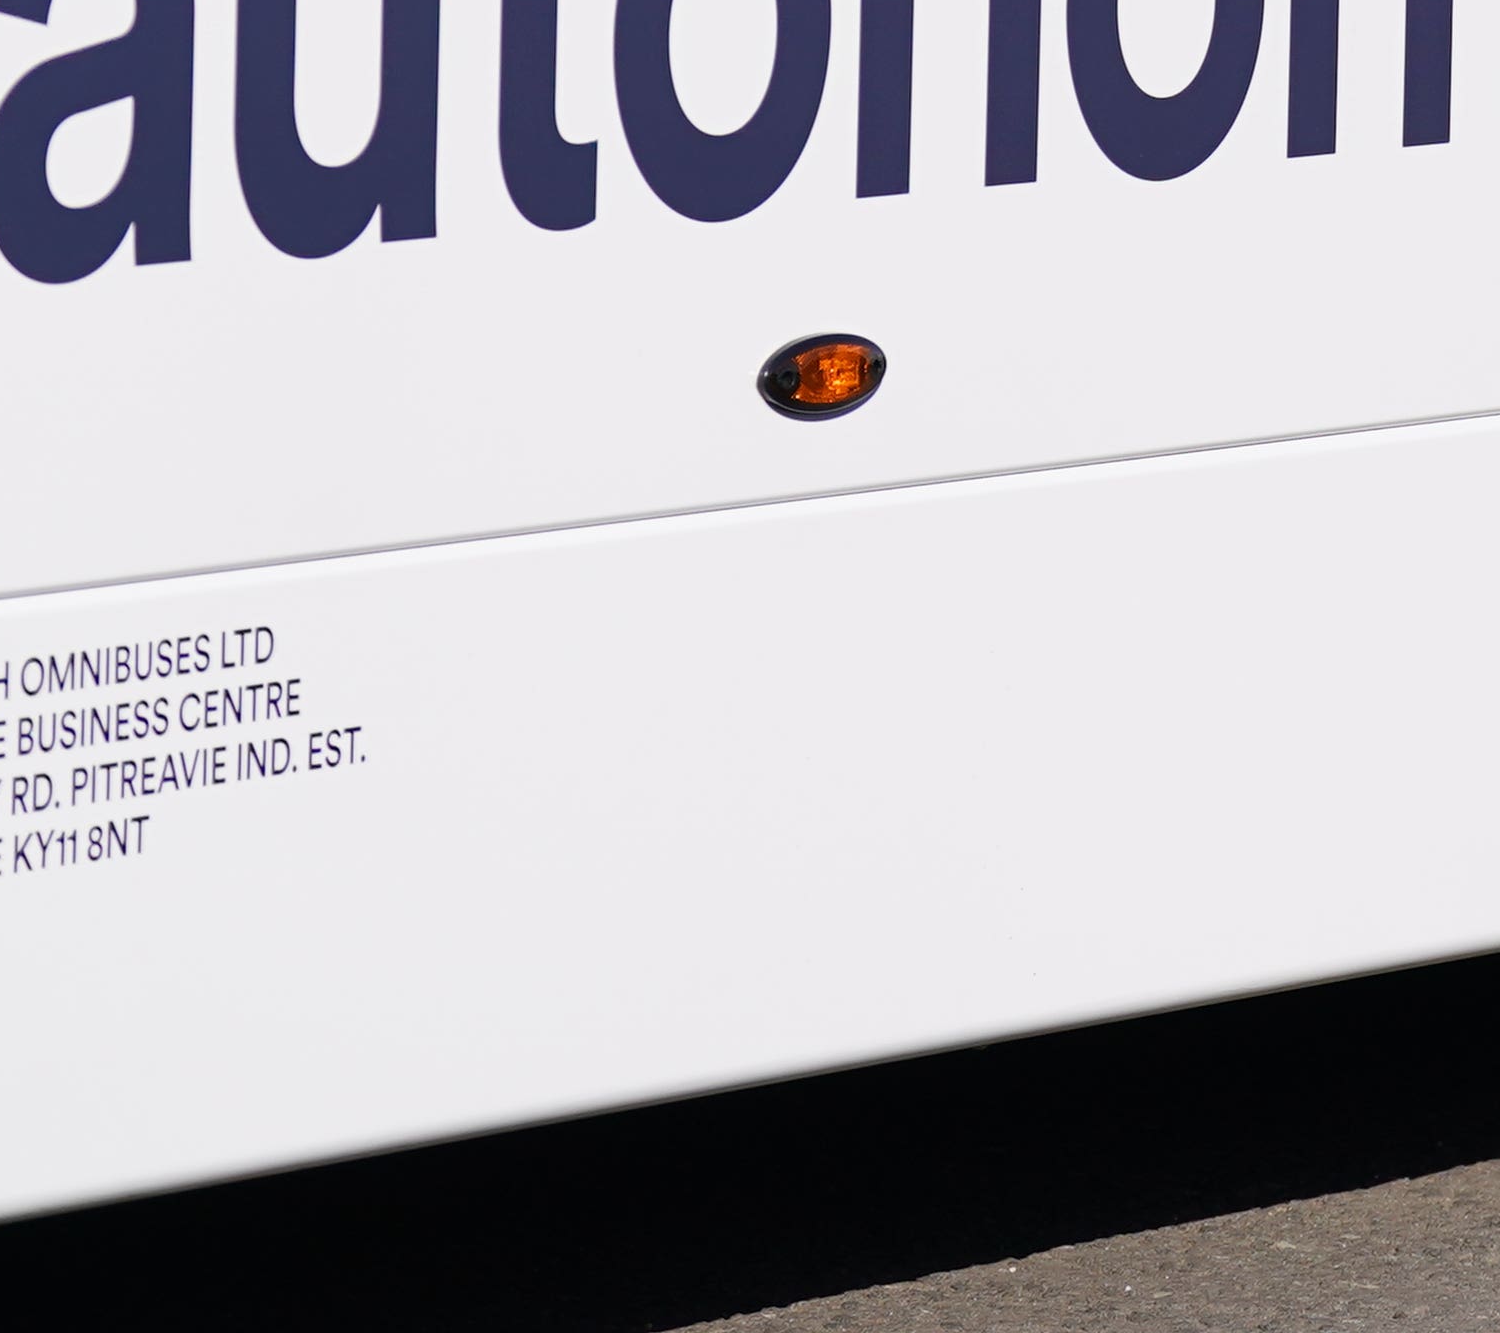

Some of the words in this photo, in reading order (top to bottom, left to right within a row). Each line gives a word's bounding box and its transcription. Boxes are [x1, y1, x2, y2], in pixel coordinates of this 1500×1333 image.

[20, 633, 211, 698] OMNIBUSES
[220, 625, 275, 670] LTD
[18, 696, 170, 758] BUSINESS
[178, 677, 302, 734] CENTRE
[11, 774, 61, 815] RD.
[70, 745, 228, 807] PITREAVIE
[236, 740, 298, 783] IND.
[307, 726, 367, 772] EST.
[12, 828, 79, 874] KY11
[86, 815, 150, 863] 8NT
